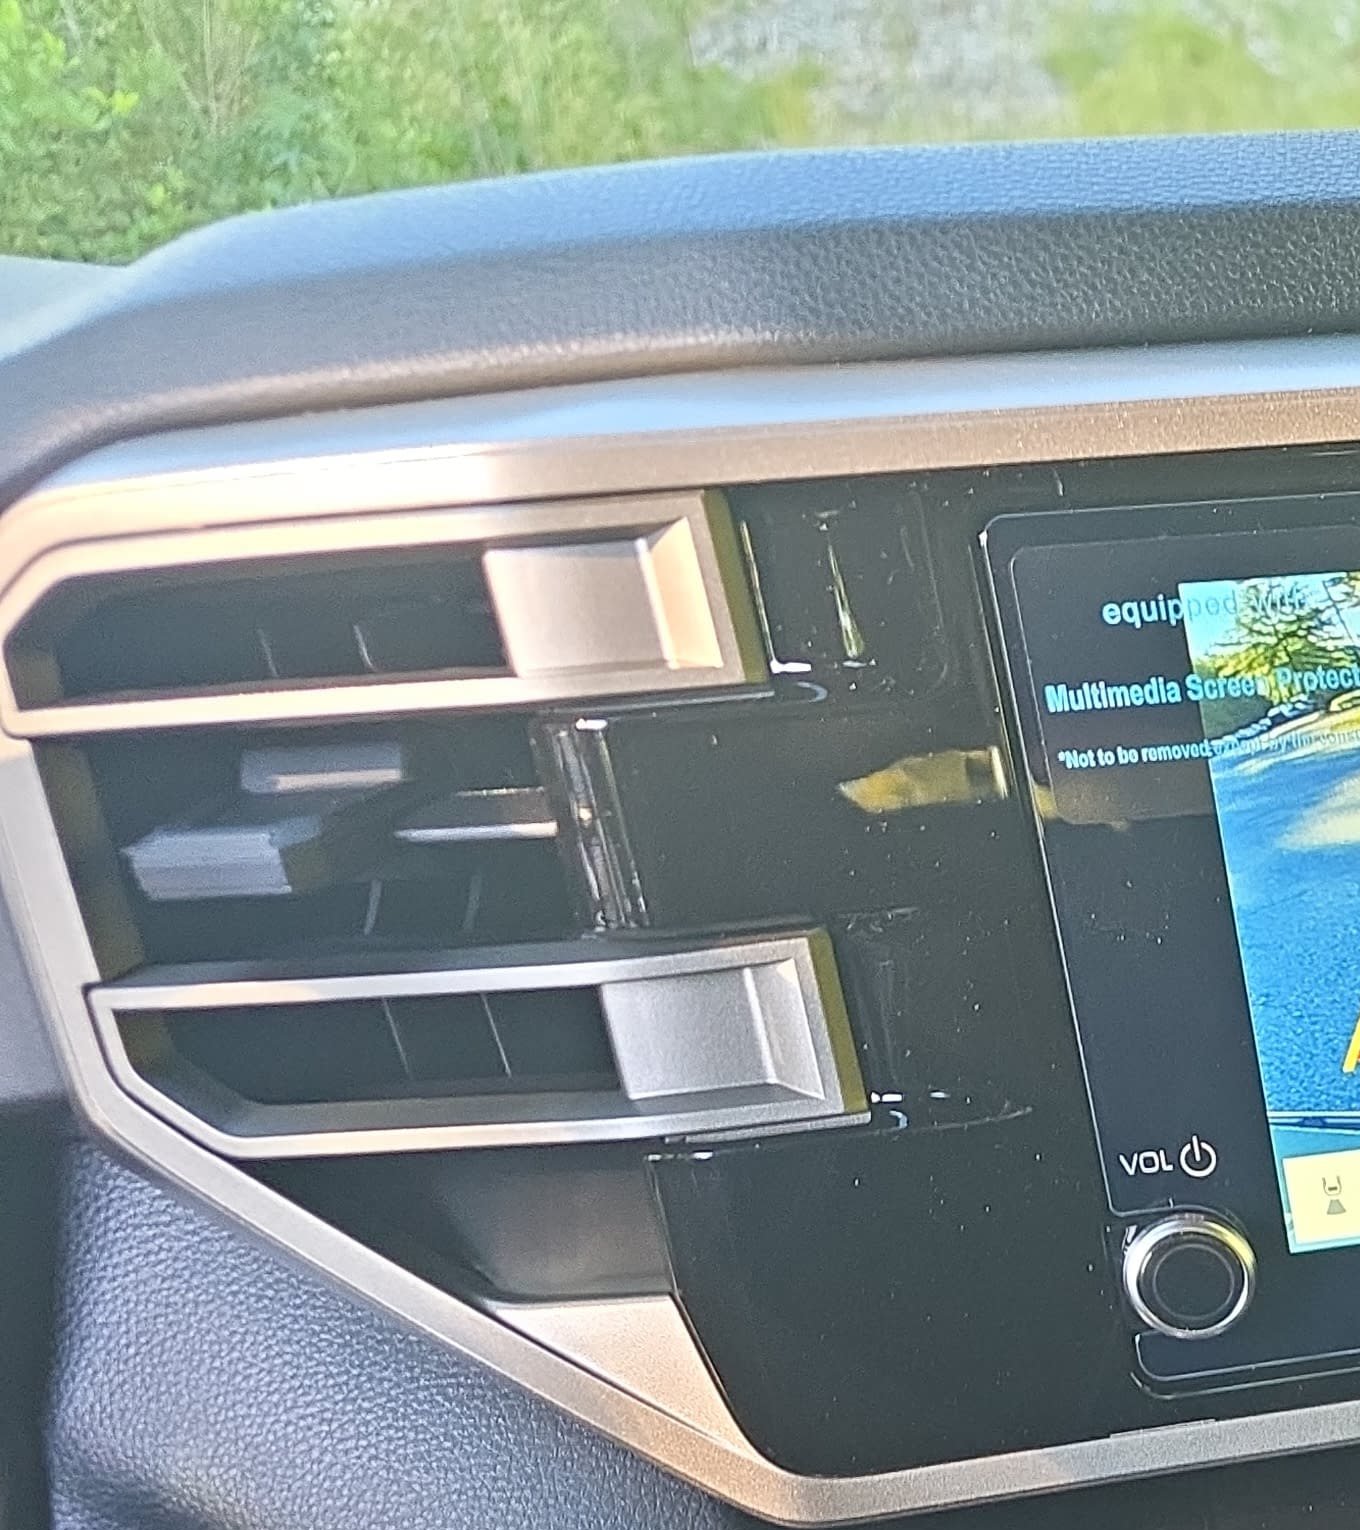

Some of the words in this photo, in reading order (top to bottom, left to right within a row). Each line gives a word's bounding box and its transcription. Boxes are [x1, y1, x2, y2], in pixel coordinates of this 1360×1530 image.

[1102, 588, 1238, 629] equipped
[1044, 673, 1182, 714] Multimedia
[1185, 672, 1269, 701] Screen
[1097, 747, 1115, 767] to
[1118, 746, 1139, 766] be
[1119, 1150, 1173, 1176] VOL
